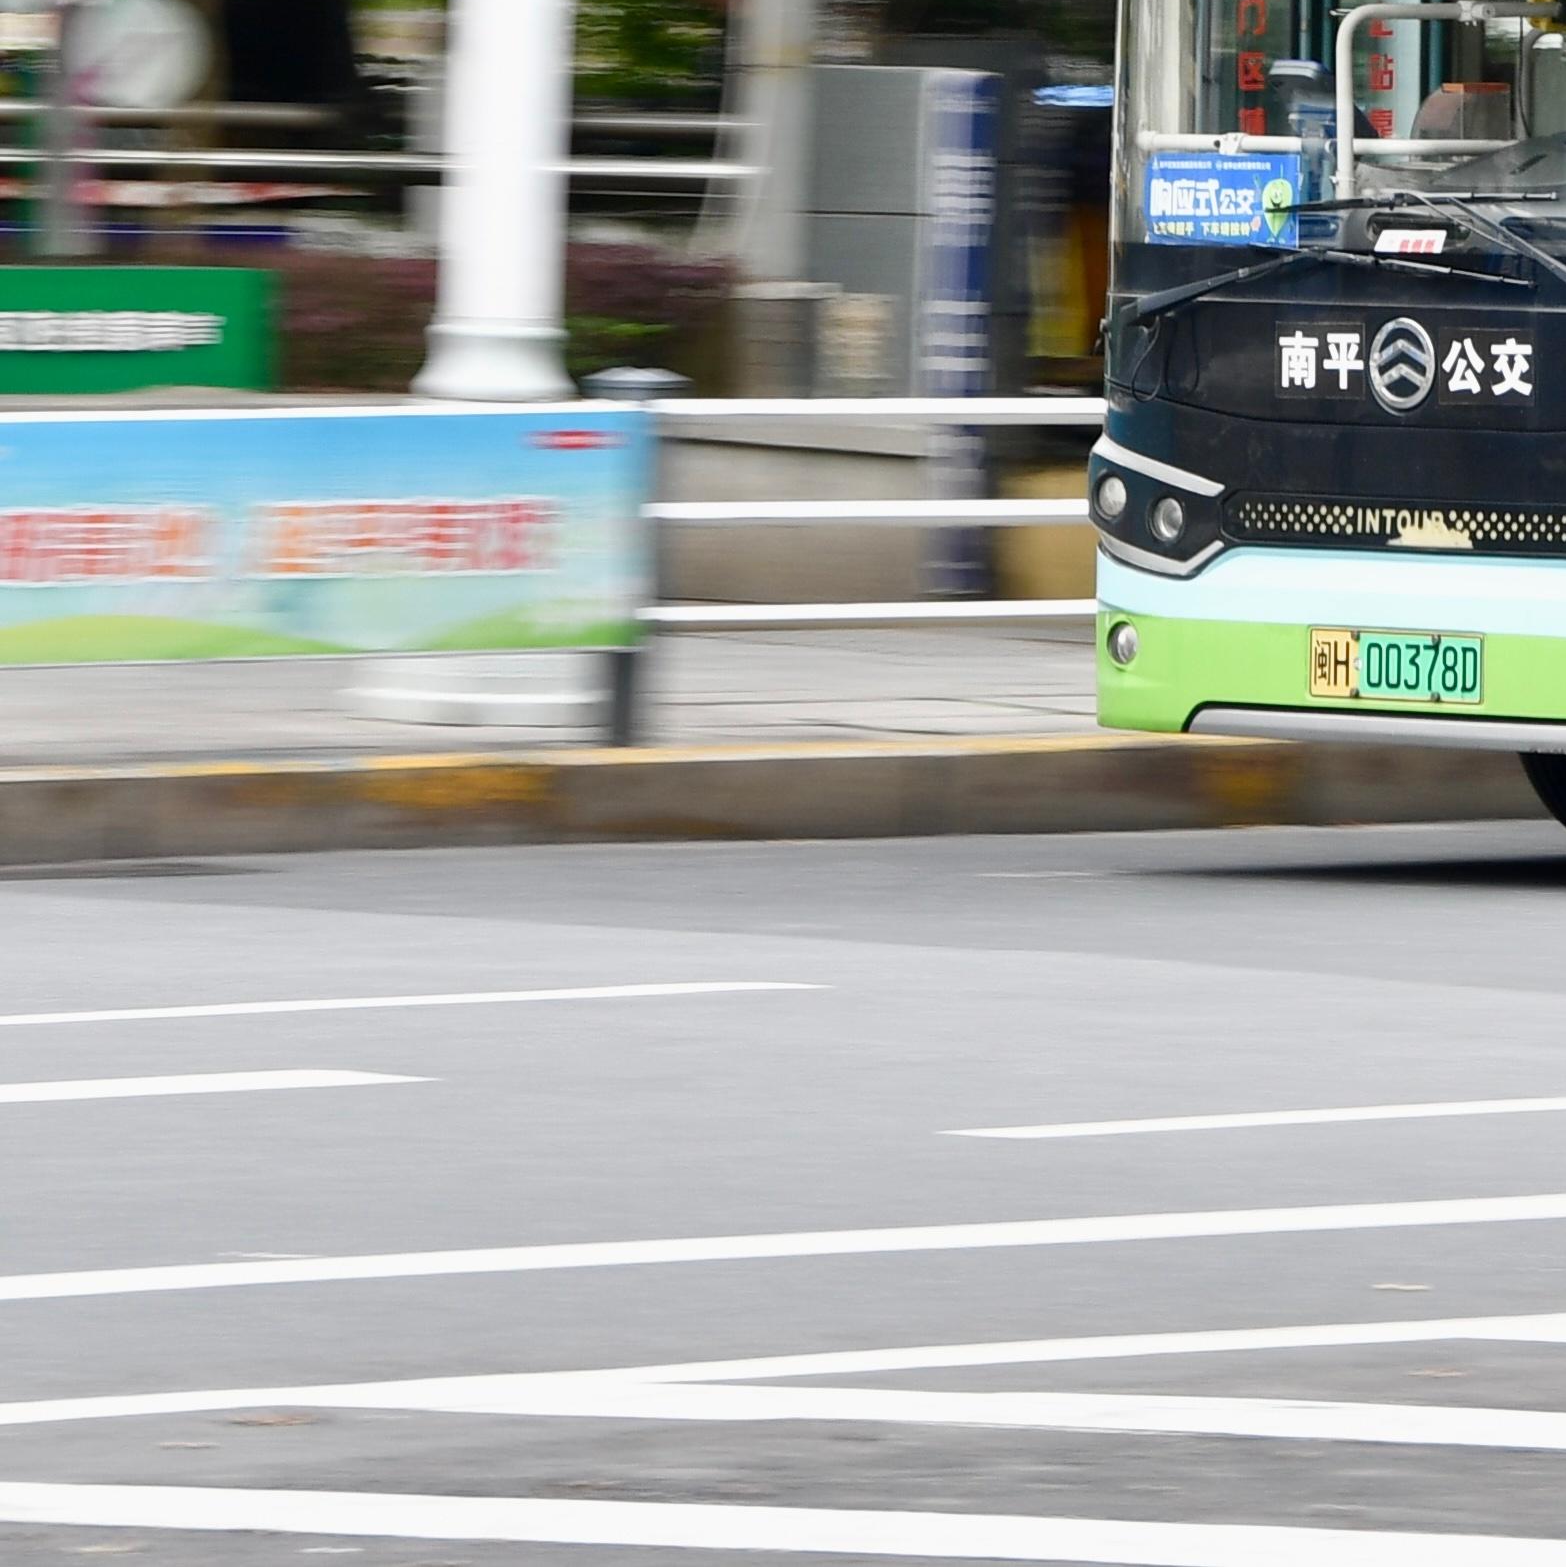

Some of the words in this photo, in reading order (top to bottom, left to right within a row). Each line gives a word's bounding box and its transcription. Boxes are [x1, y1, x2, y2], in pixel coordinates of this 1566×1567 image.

[1150, 178, 1256, 217] 响应式公交
[1279, 330, 1365, 390] 南平
[1442, 337, 1533, 396] 公交
